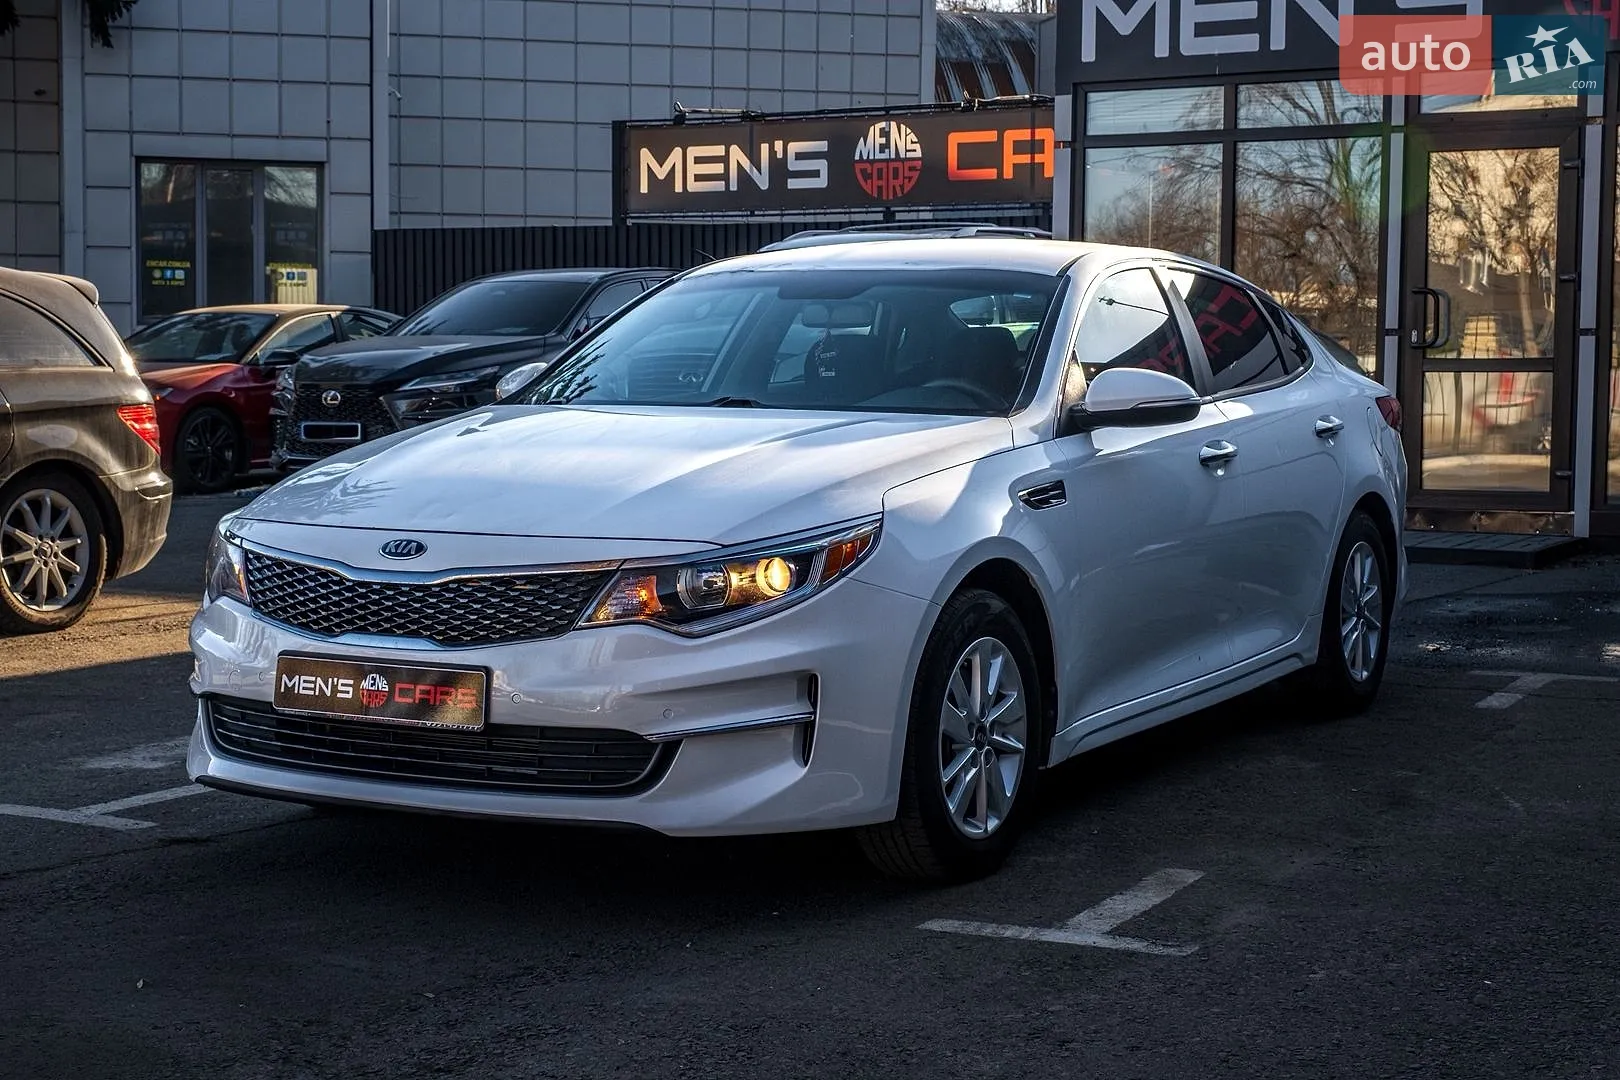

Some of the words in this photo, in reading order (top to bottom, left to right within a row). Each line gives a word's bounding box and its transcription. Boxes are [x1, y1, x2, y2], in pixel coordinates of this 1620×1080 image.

[854, 120, 922, 160] MEN'S
[639, 140, 828, 194] MEN'S
[854, 160, 922, 200] CARS
[385, 541, 418, 555] KIA
[280, 673, 354, 699] MEN'S
[394, 682, 477, 710] CARS
[360, 673, 389, 691] MEN'S
